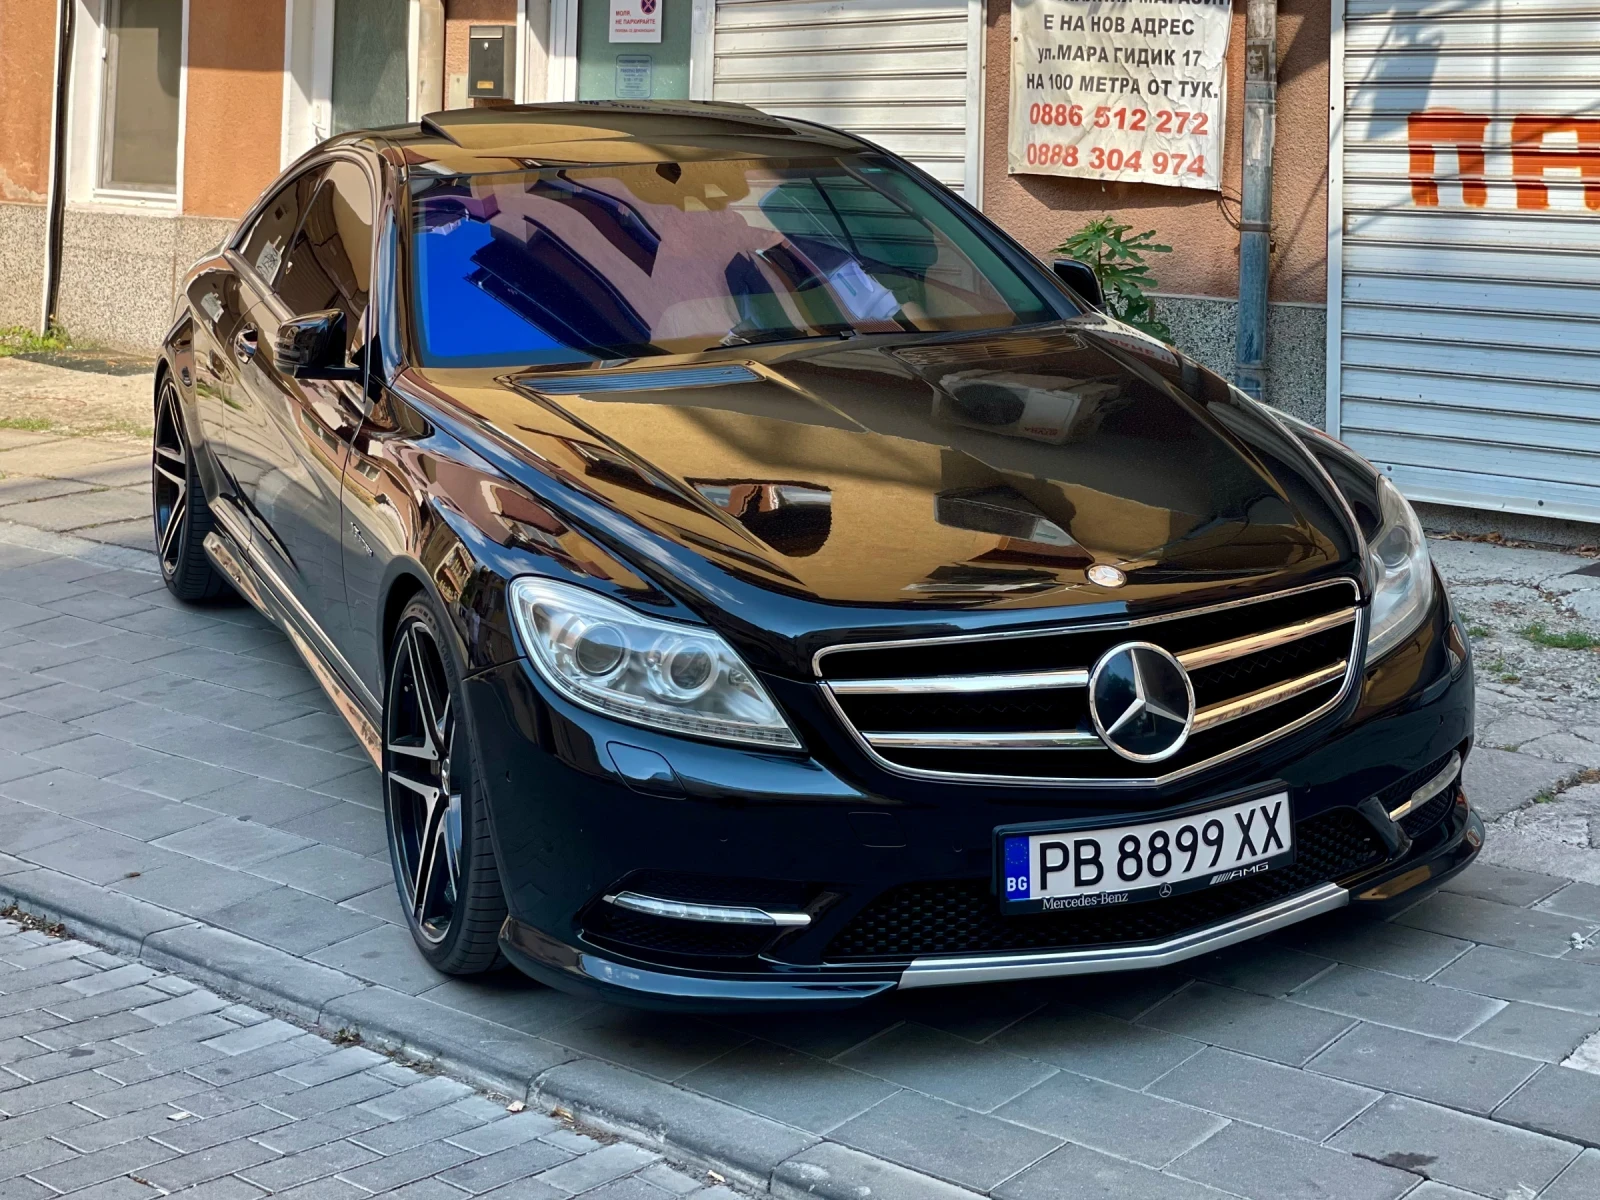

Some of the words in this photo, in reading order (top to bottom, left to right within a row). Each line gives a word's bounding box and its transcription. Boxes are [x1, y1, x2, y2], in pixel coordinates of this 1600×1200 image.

[1044, 14, 1055, 30] Е
[1060, 15, 1085, 32] НА
[1091, 16, 1125, 33] НОВ
[1131, 18, 1195, 37] АДРЕС
[1113, 48, 1176, 68] ГИДИК
[1182, 50, 1201, 67] 17
[1026, 73, 1044, 90] НА
[1048, 73, 1073, 91] 100
[1079, 75, 1141, 95] МЕТРА
[1147, 79, 1172, 96] ОТ
[1178, 80, 1218, 99] ТУК.
[1030, 102, 1083, 127] 0886
[1093, 106, 1147, 132] 512
[1155, 109, 1209, 136] 272
[1027, 143, 1079, 167] 0888
[1089, 146, 1142, 173] 304
[1152, 151, 1206, 178] 974
[1039, 838, 1104, 891] PB
[1116, 818, 1224, 882] 8899
[1234, 801, 1284, 861] XX
[1227, 861, 1269, 880] AMG
[1006, 876, 1028, 892] BG
[1042, 892, 1128, 911] Mercedes-Benz
